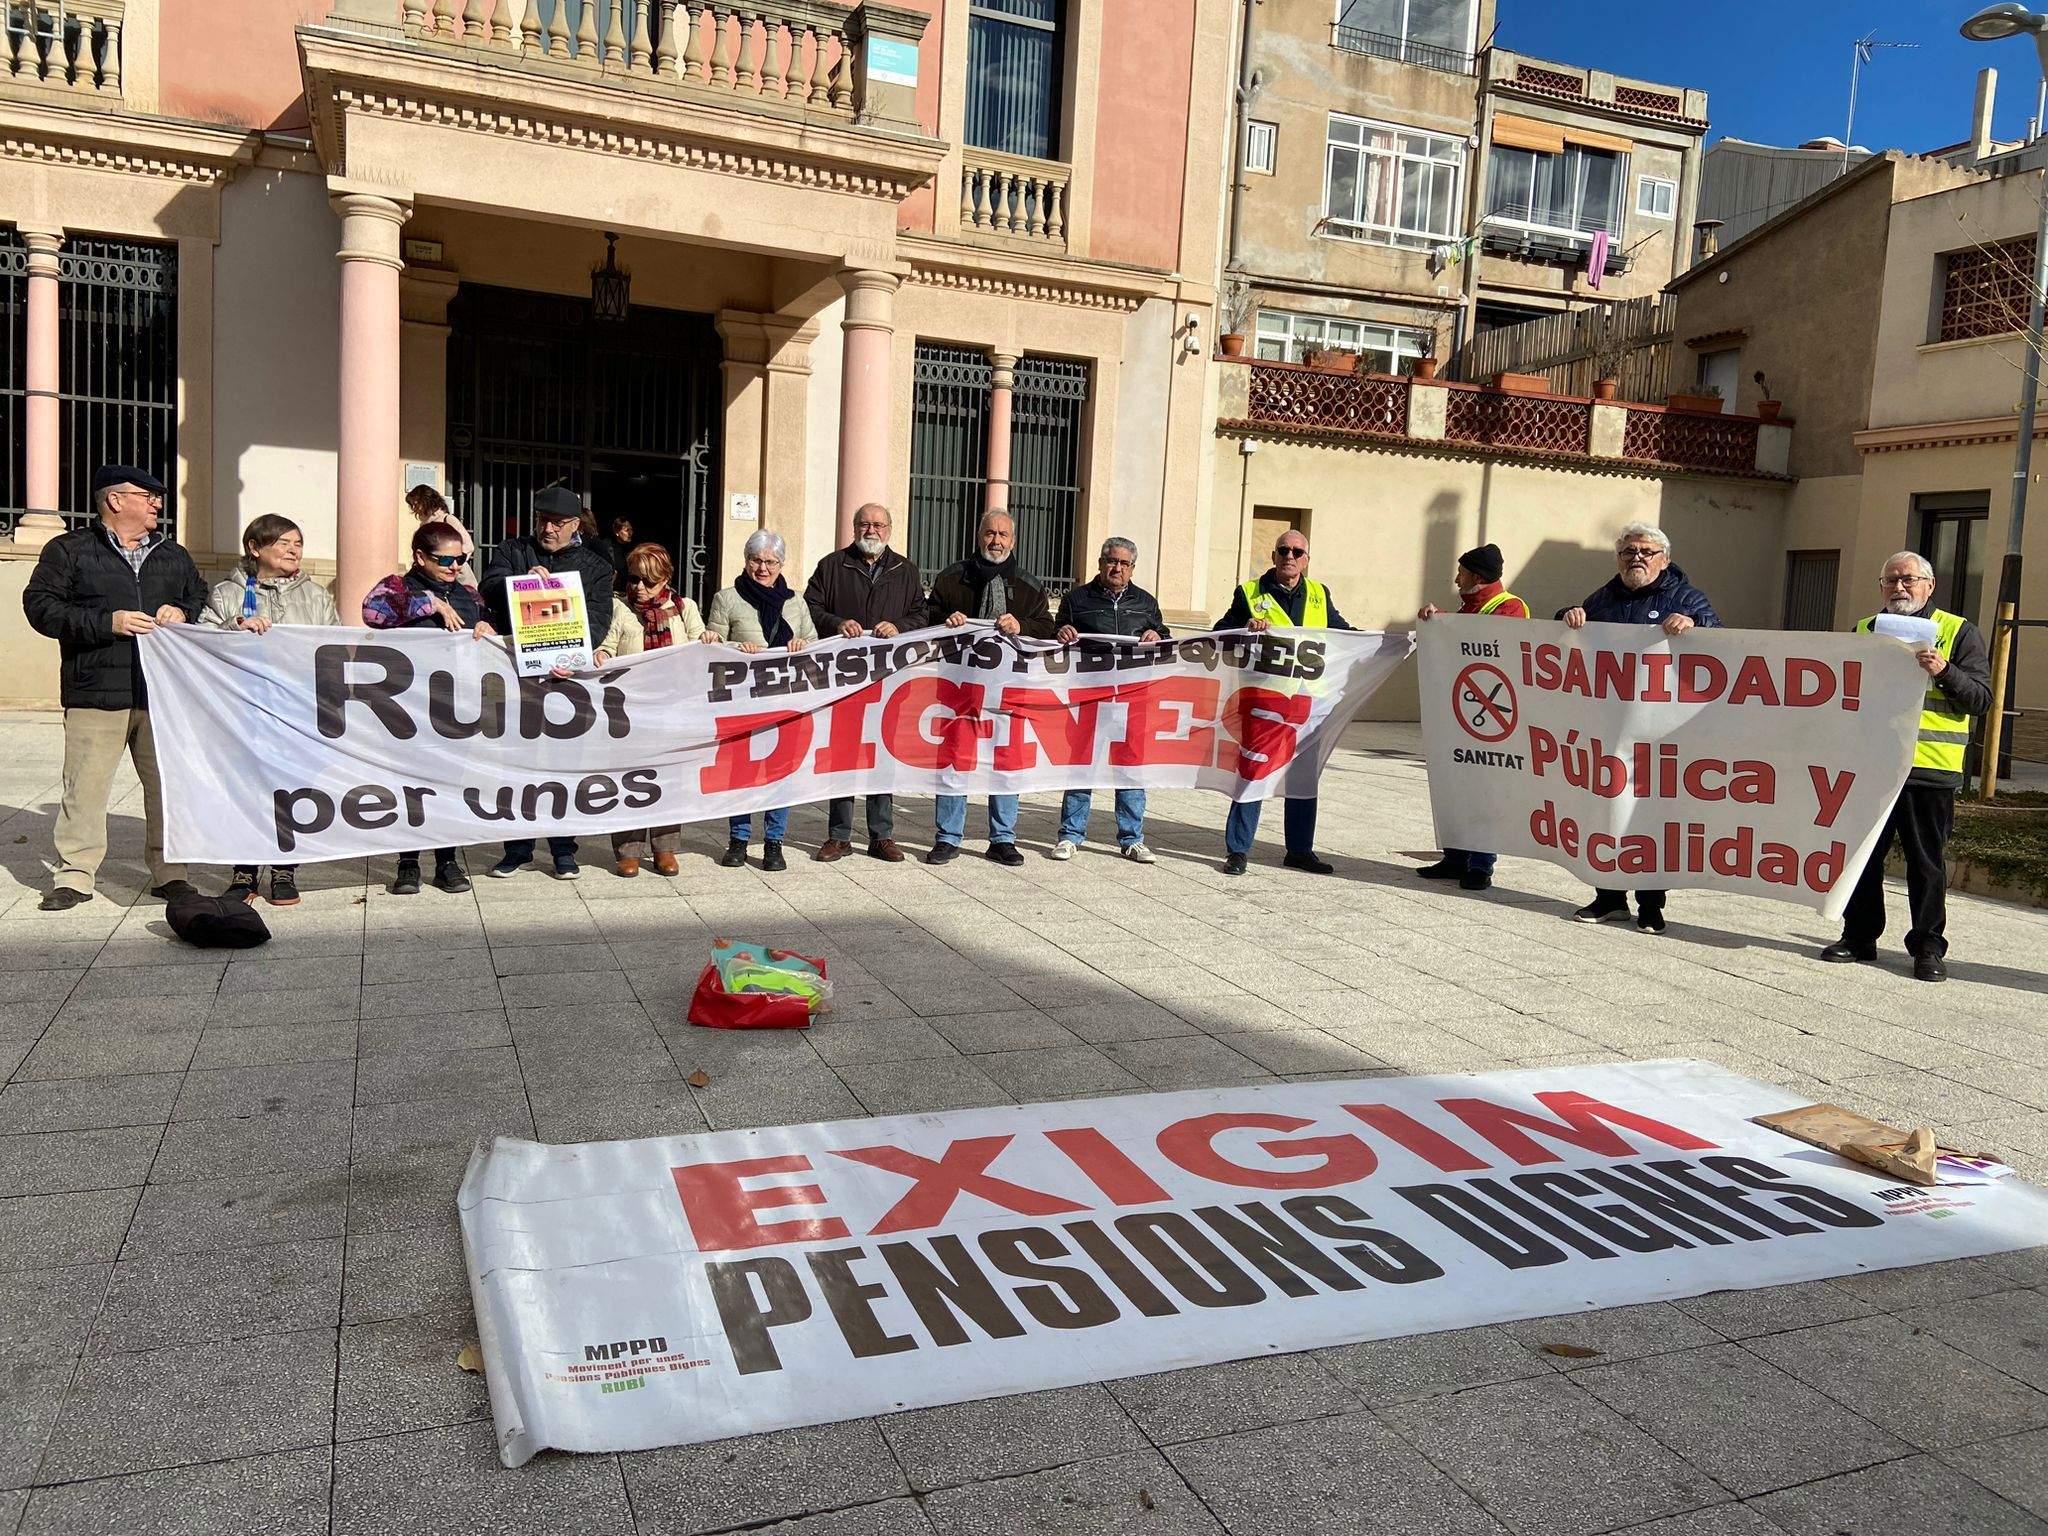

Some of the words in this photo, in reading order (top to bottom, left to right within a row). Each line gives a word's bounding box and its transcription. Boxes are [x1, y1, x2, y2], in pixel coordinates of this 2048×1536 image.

[708, 632, 1003, 703] PENSIONS
[1461, 640, 1501, 658] RUBÍ
[315, 644, 632, 740] Rubí
[699, 675, 1312, 795] DIGNES
[1453, 748, 1525, 771] SANITAT
[273, 784, 437, 852] per
[463, 769, 662, 824] unes
[1528, 725, 1776, 805] Pública
[1808, 765, 1856, 828] y
[1586, 822, 1847, 894] calidad
[671, 1091, 1723, 1253] EXIGIM
[704, 1195, 1445, 1376] PENSIONS
[1390, 1156, 1885, 1270] DIGNES
[568, 1360, 627, 1373] Moviment
[631, 1358, 652, 1367] per
[656, 1353, 685, 1363] unes
[584, 1336, 668, 1361] MPPD
